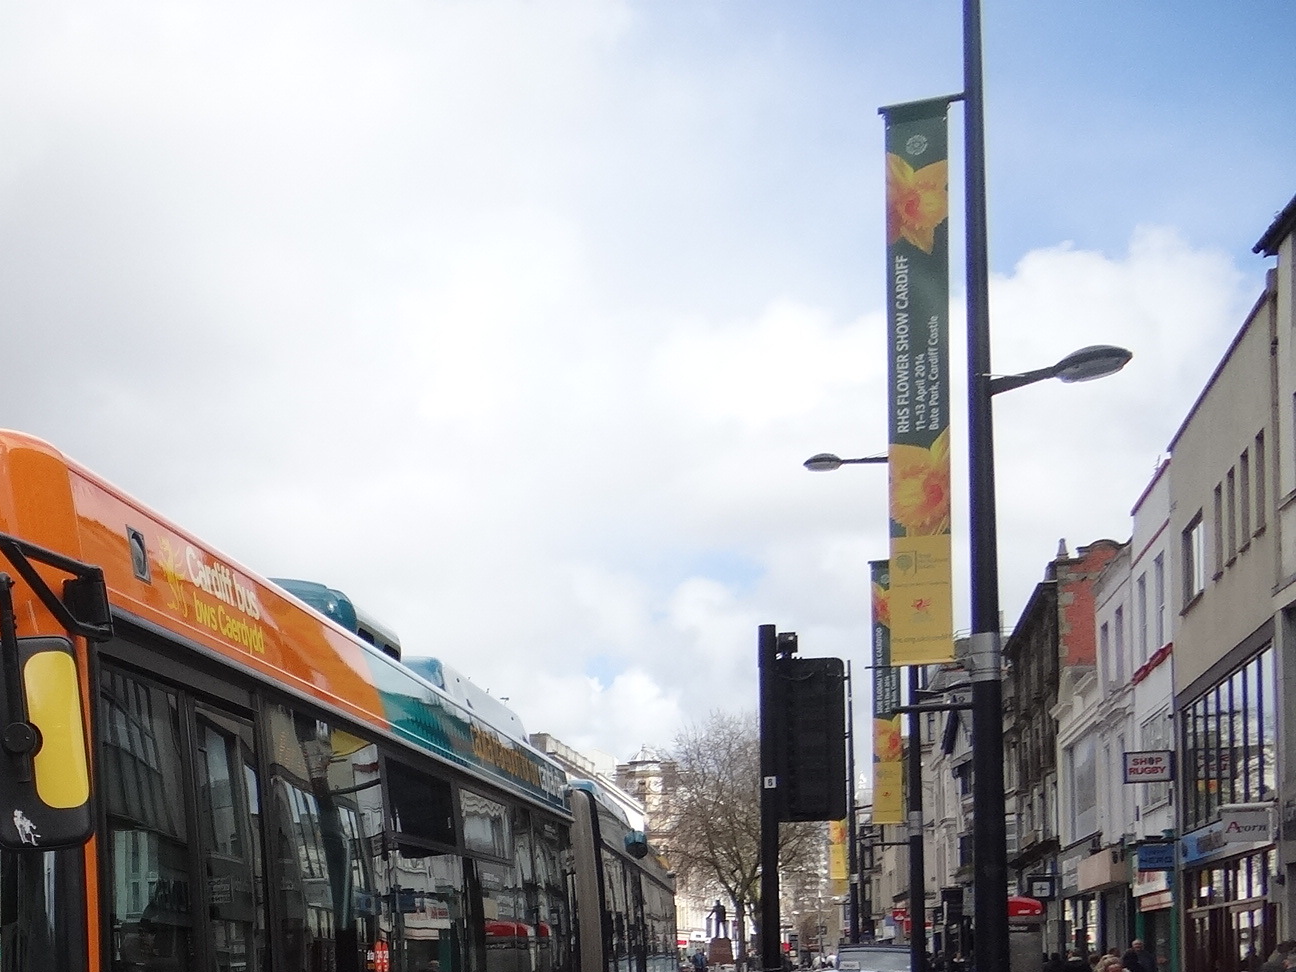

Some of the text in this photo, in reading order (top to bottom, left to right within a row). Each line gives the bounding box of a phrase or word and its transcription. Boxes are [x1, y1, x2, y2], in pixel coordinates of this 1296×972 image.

[927, 315, 939, 346] Castle
[895, 255, 910, 433] RHS FLOWER SHOW CARDIFF
[914, 353, 926, 378] 2014
[927, 347, 939, 380] Cardiff
[914, 379, 928, 402] April
[929, 408, 940, 431] Bute
[185, 545, 260, 621] Cardiff bus
[193, 591, 265, 655] bws Caerdydd
[1129, 766, 1166, 775] RUGBY
[1132, 756, 1163, 766] SHOP
[1225, 820, 1268, 834] Acorn
